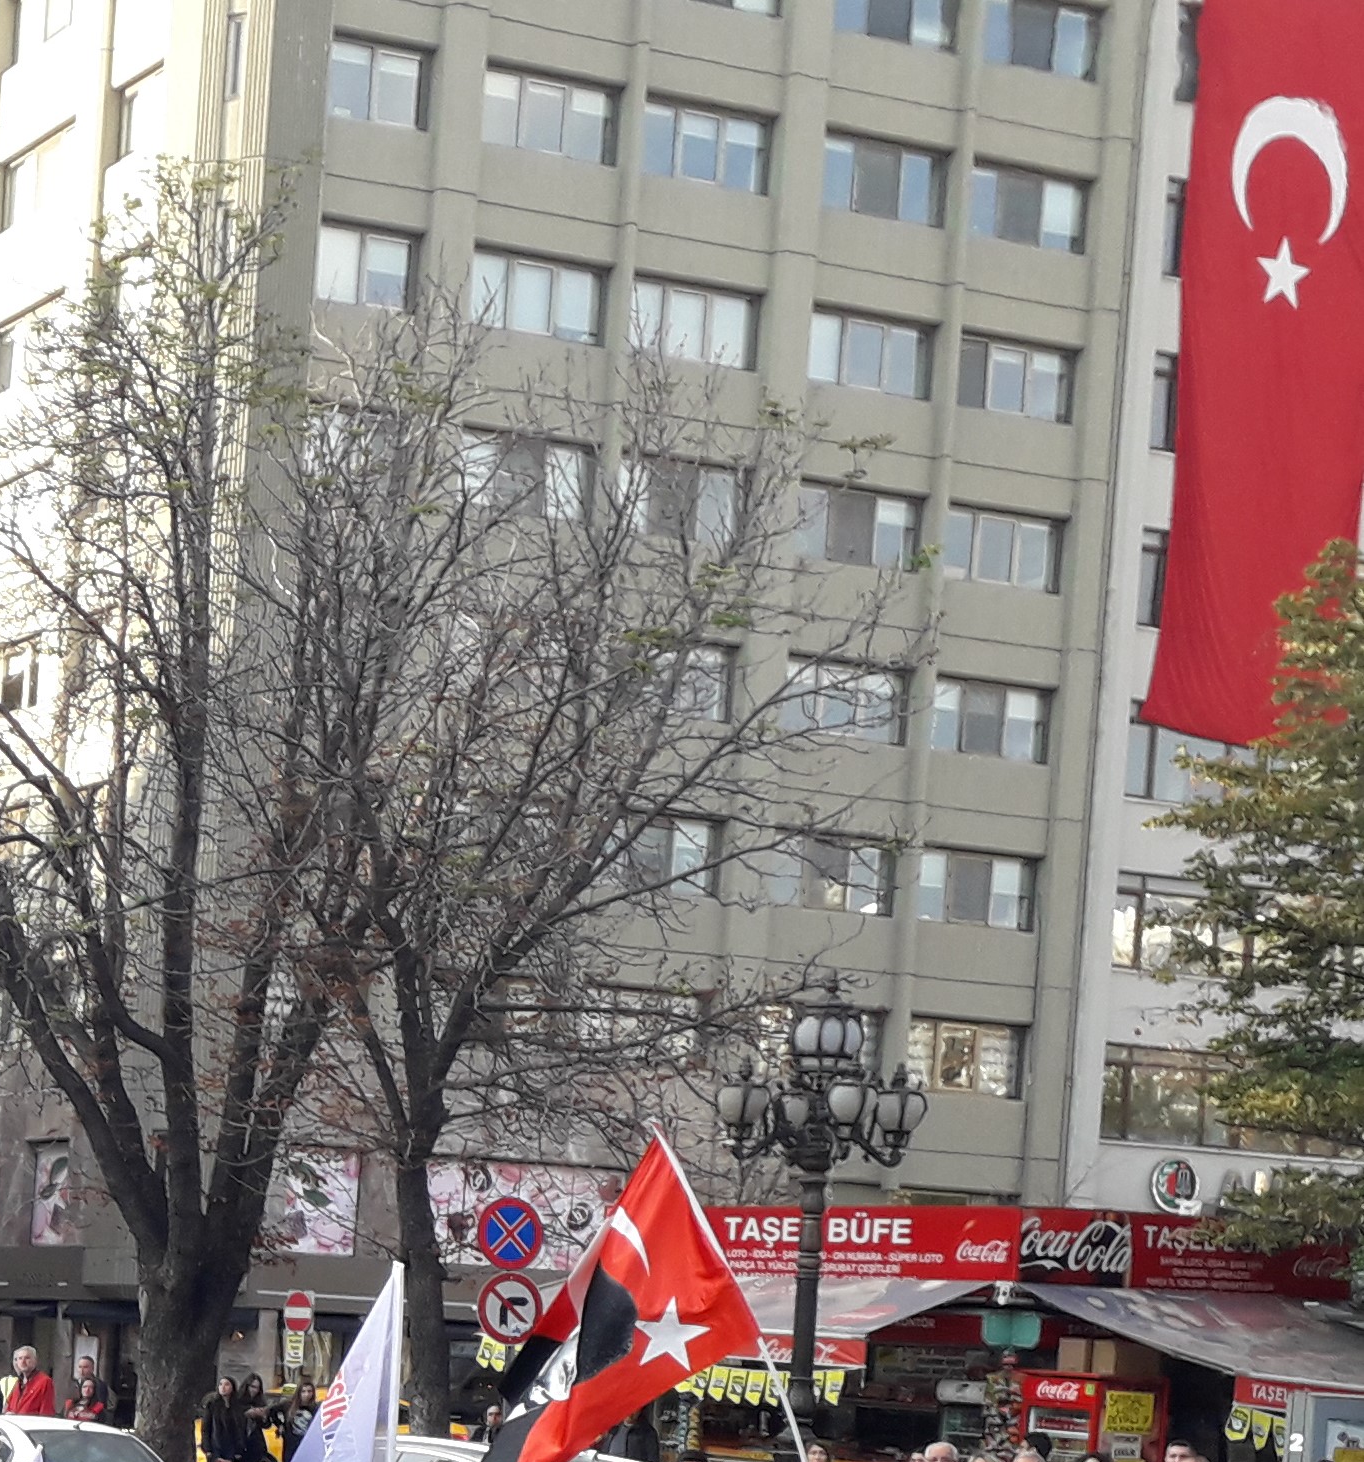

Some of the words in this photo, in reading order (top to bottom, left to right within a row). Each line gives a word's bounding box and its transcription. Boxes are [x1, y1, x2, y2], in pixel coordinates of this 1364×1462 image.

[724, 1215, 801, 1248] TAŞE
[827, 1211, 913, 1245] BÜFE
[1289, 1432, 1304, 1452] 2
